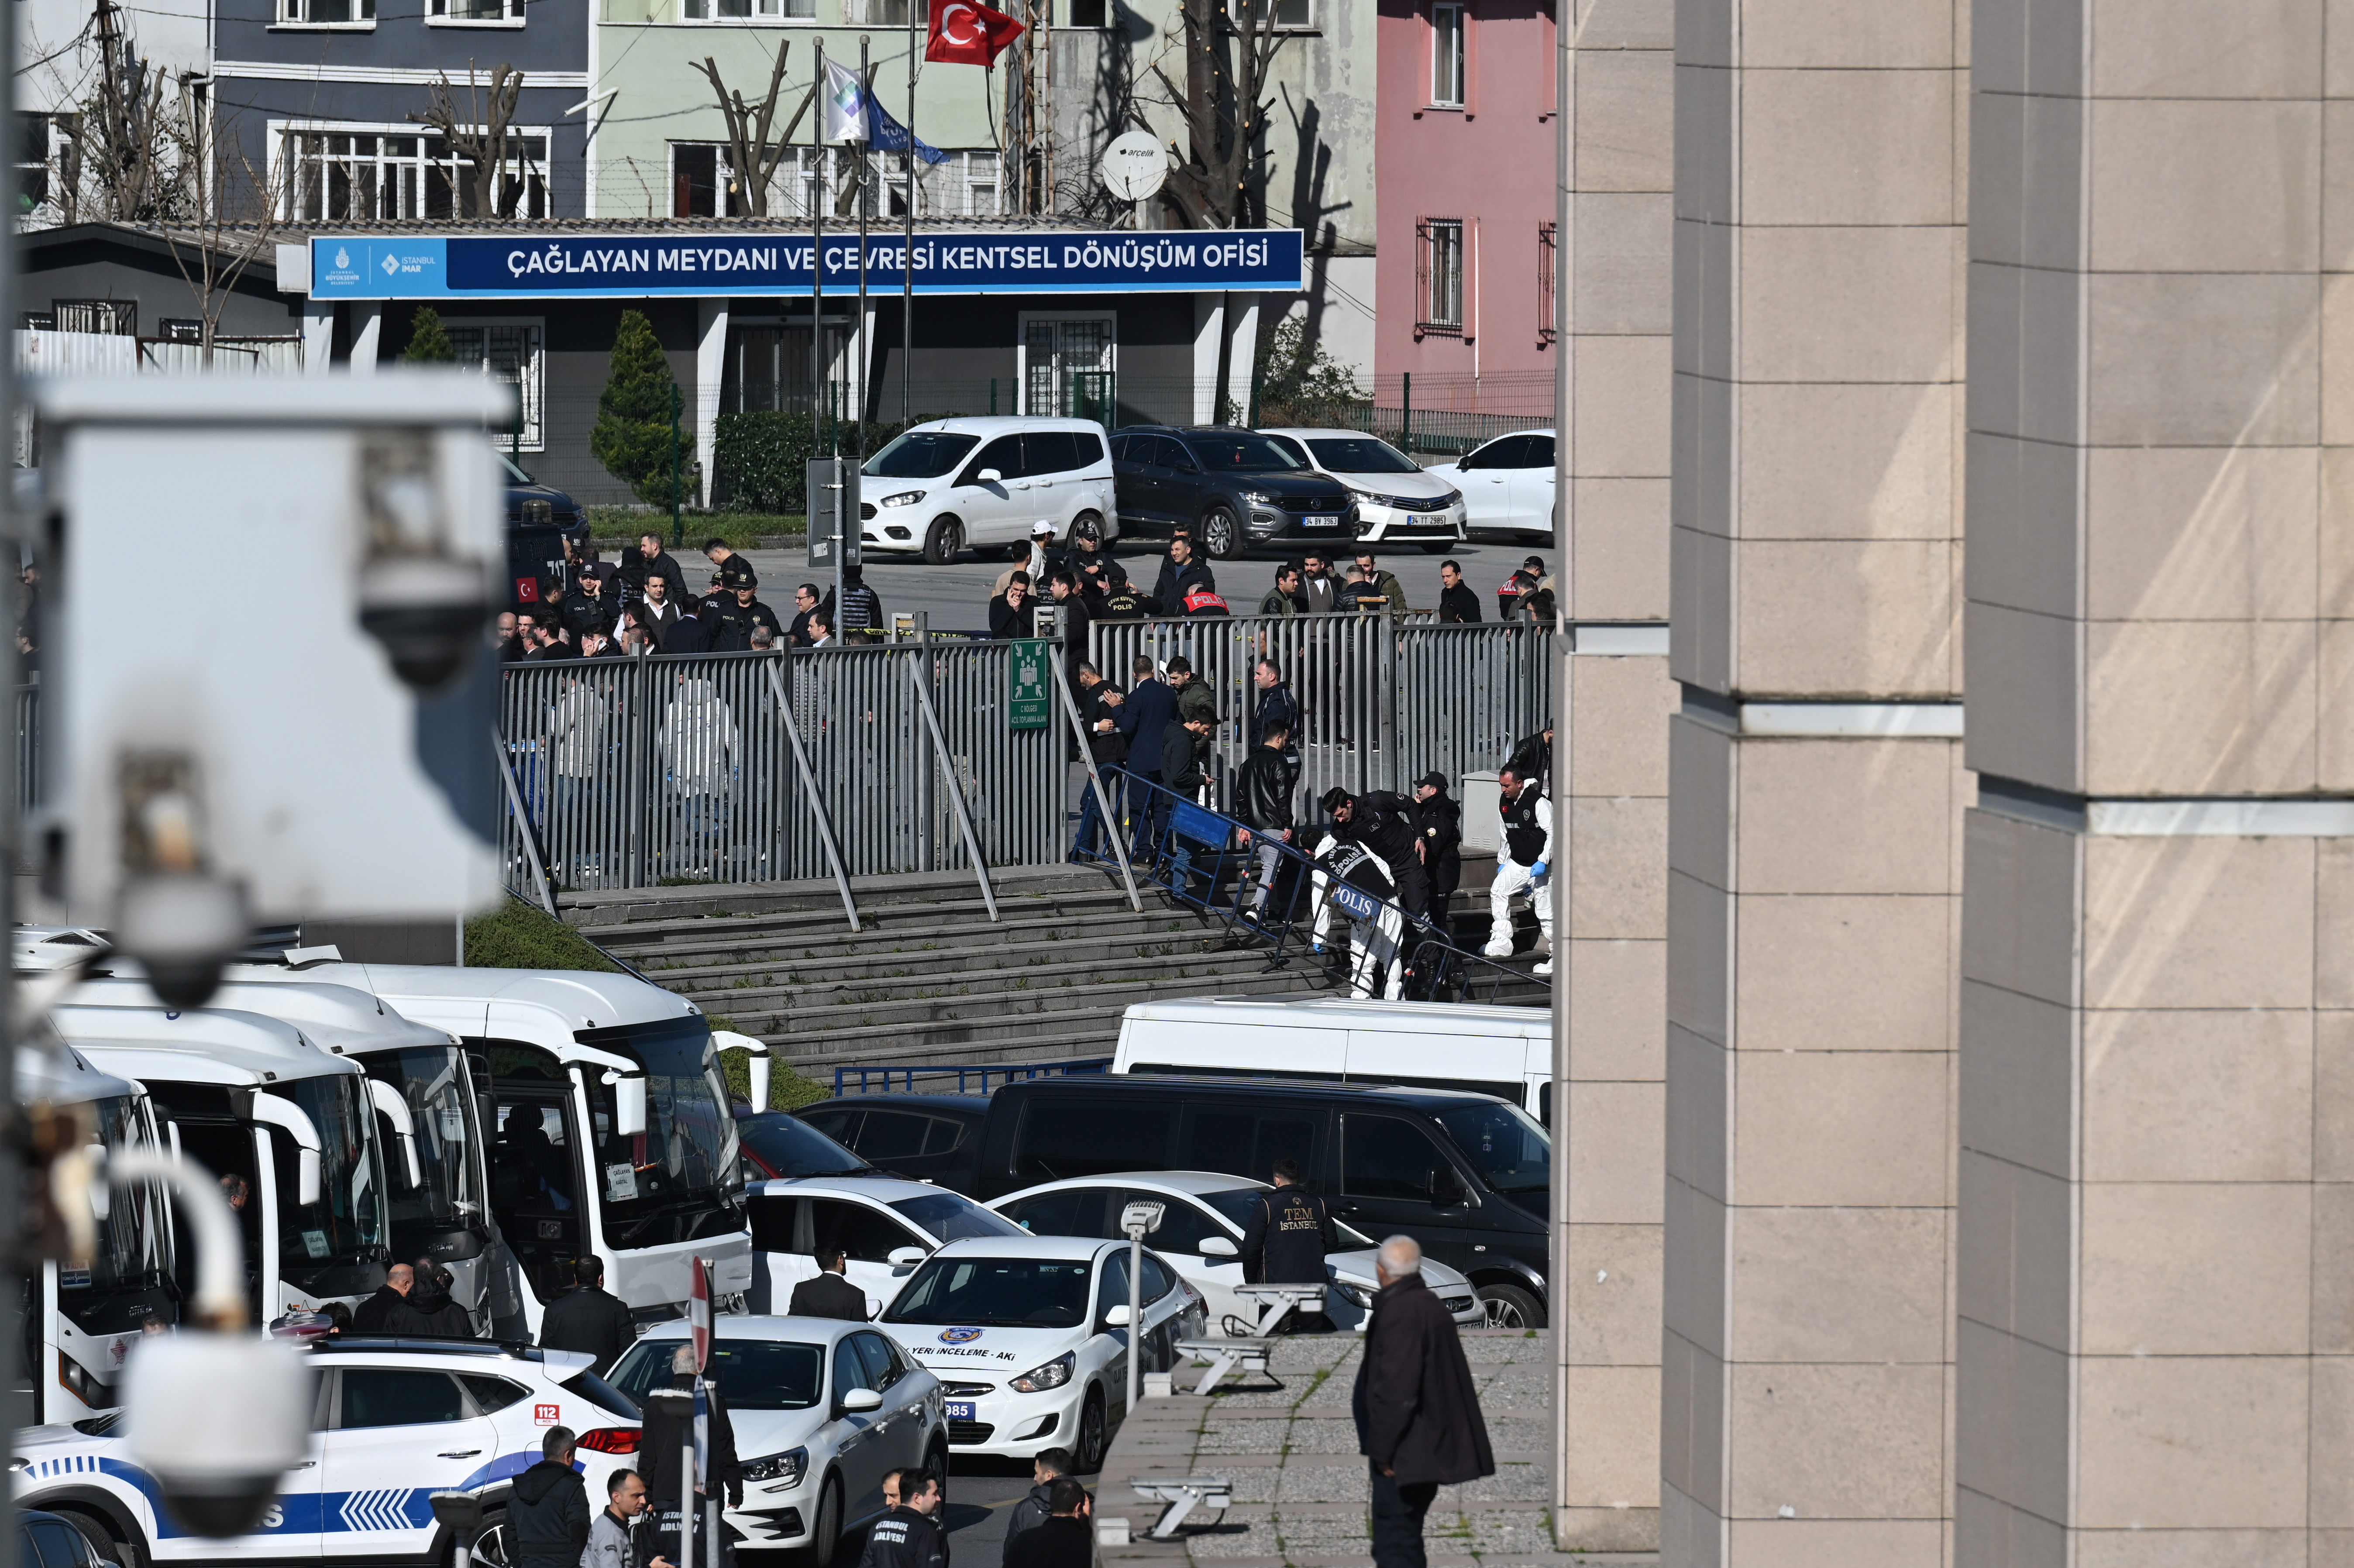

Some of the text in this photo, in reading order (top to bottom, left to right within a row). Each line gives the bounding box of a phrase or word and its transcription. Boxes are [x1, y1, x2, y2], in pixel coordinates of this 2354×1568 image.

[1128, 149, 1154, 158] arçelik
[508, 238, 1267, 278] ÇAĞLAYAN MEYDANI VE ÇEVRESİ KENTSEL DÖNÜŞÜM OFİSİ
[1328, 861, 1341, 875] OLAY
[1330, 886, 1372, 915] POLİS
[1284, 1207, 1314, 1221] TEM
[1280, 1221, 1318, 1231] İSTANBUL
[537, 1406, 556, 1418] 112
[946, 1405, 968, 1417] 985
